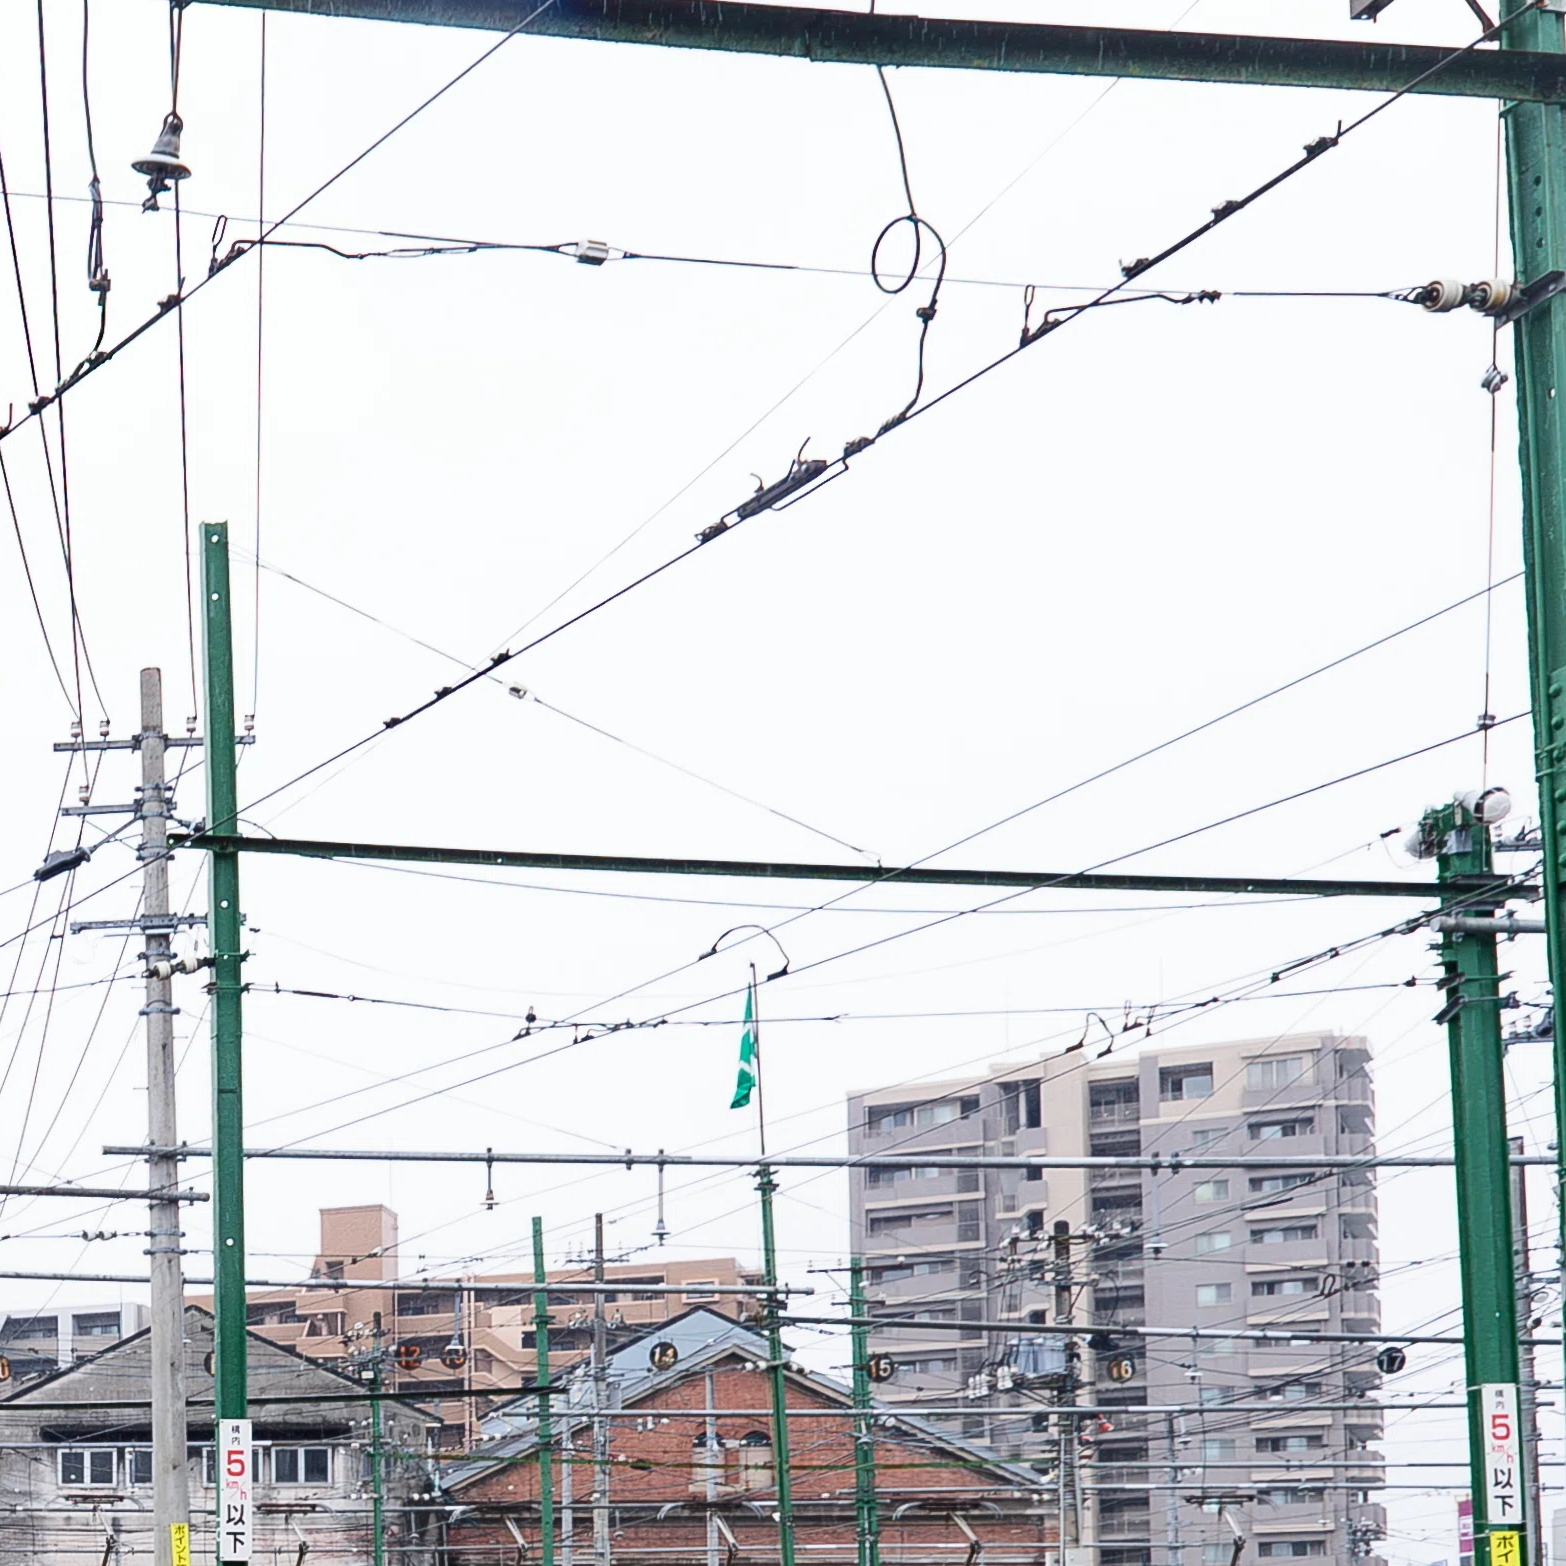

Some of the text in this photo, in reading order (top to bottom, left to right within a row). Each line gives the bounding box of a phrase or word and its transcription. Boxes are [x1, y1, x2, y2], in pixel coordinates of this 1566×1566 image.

[869, 1360, 891, 1378] 15
[1380, 1353, 1403, 1370] 17
[231, 1425, 241, 1445] 構内
[1491, 1414, 1510, 1440] 5
[227, 1450, 245, 1477] 5
[1493, 1468, 1513, 1516] 以下
[226, 1504, 245, 1554] 以下
